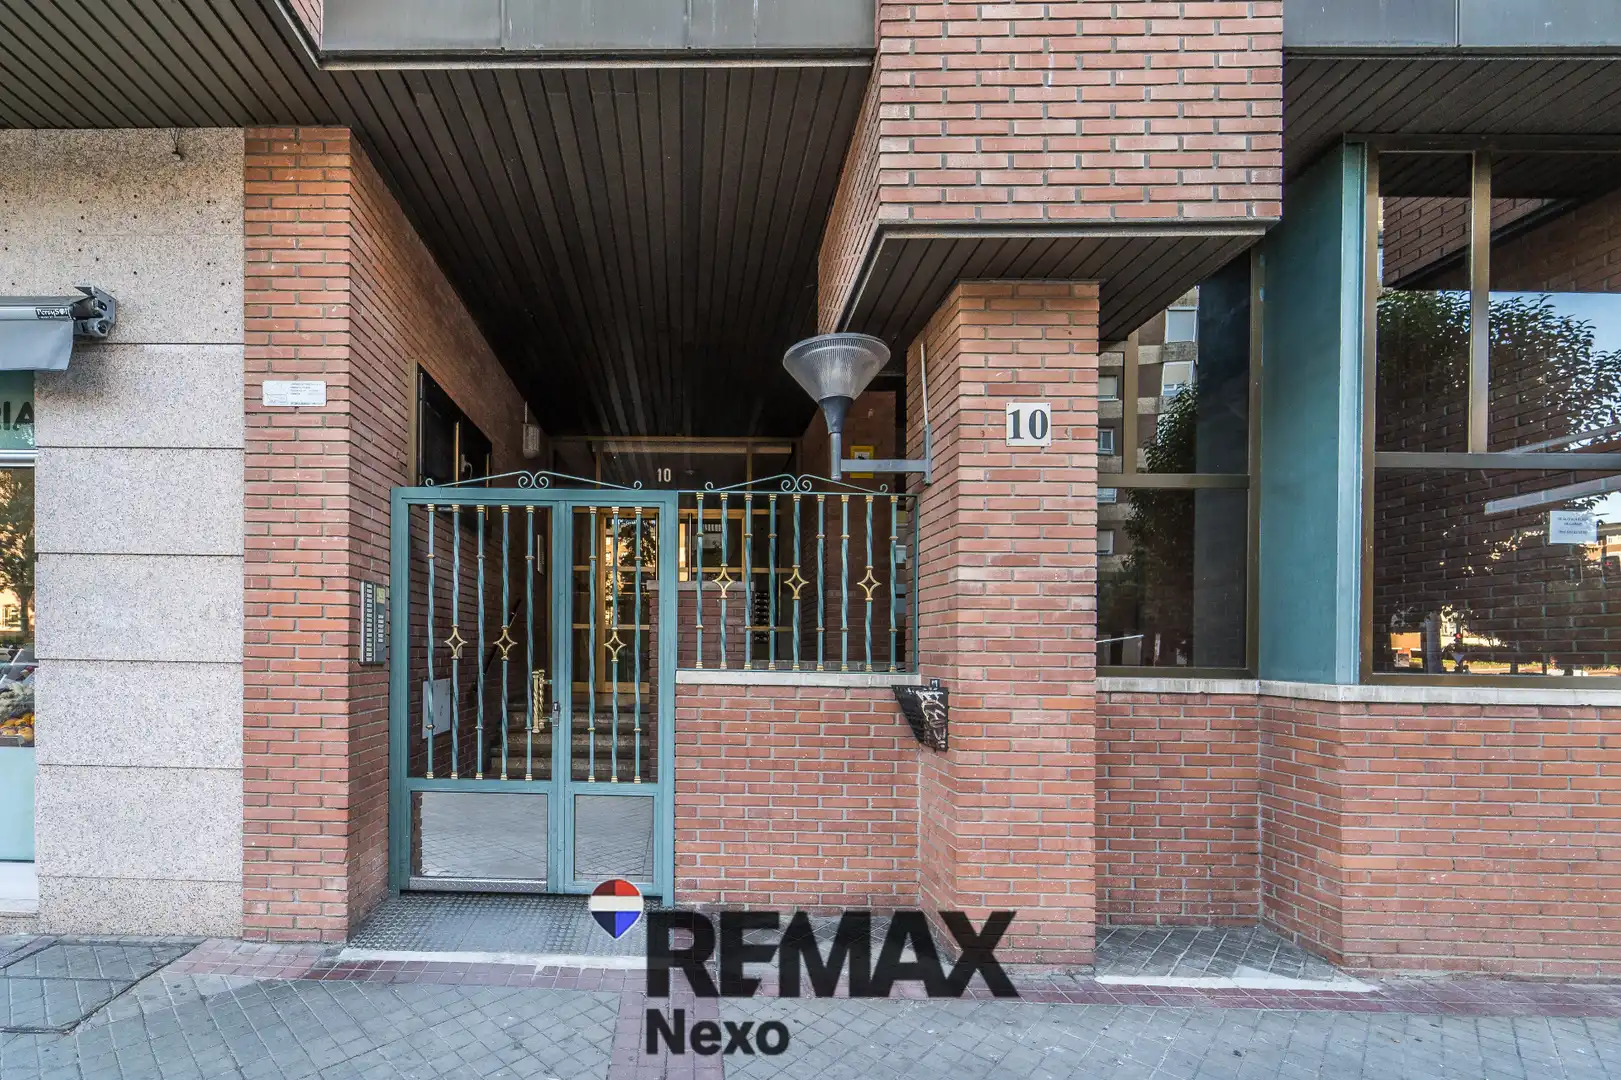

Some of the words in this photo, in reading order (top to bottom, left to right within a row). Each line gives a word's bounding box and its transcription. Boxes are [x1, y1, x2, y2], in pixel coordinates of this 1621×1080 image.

[0, 401, 35, 431] IA
[1008, 409, 1048, 440] 10
[657, 467, 671, 482] 10
